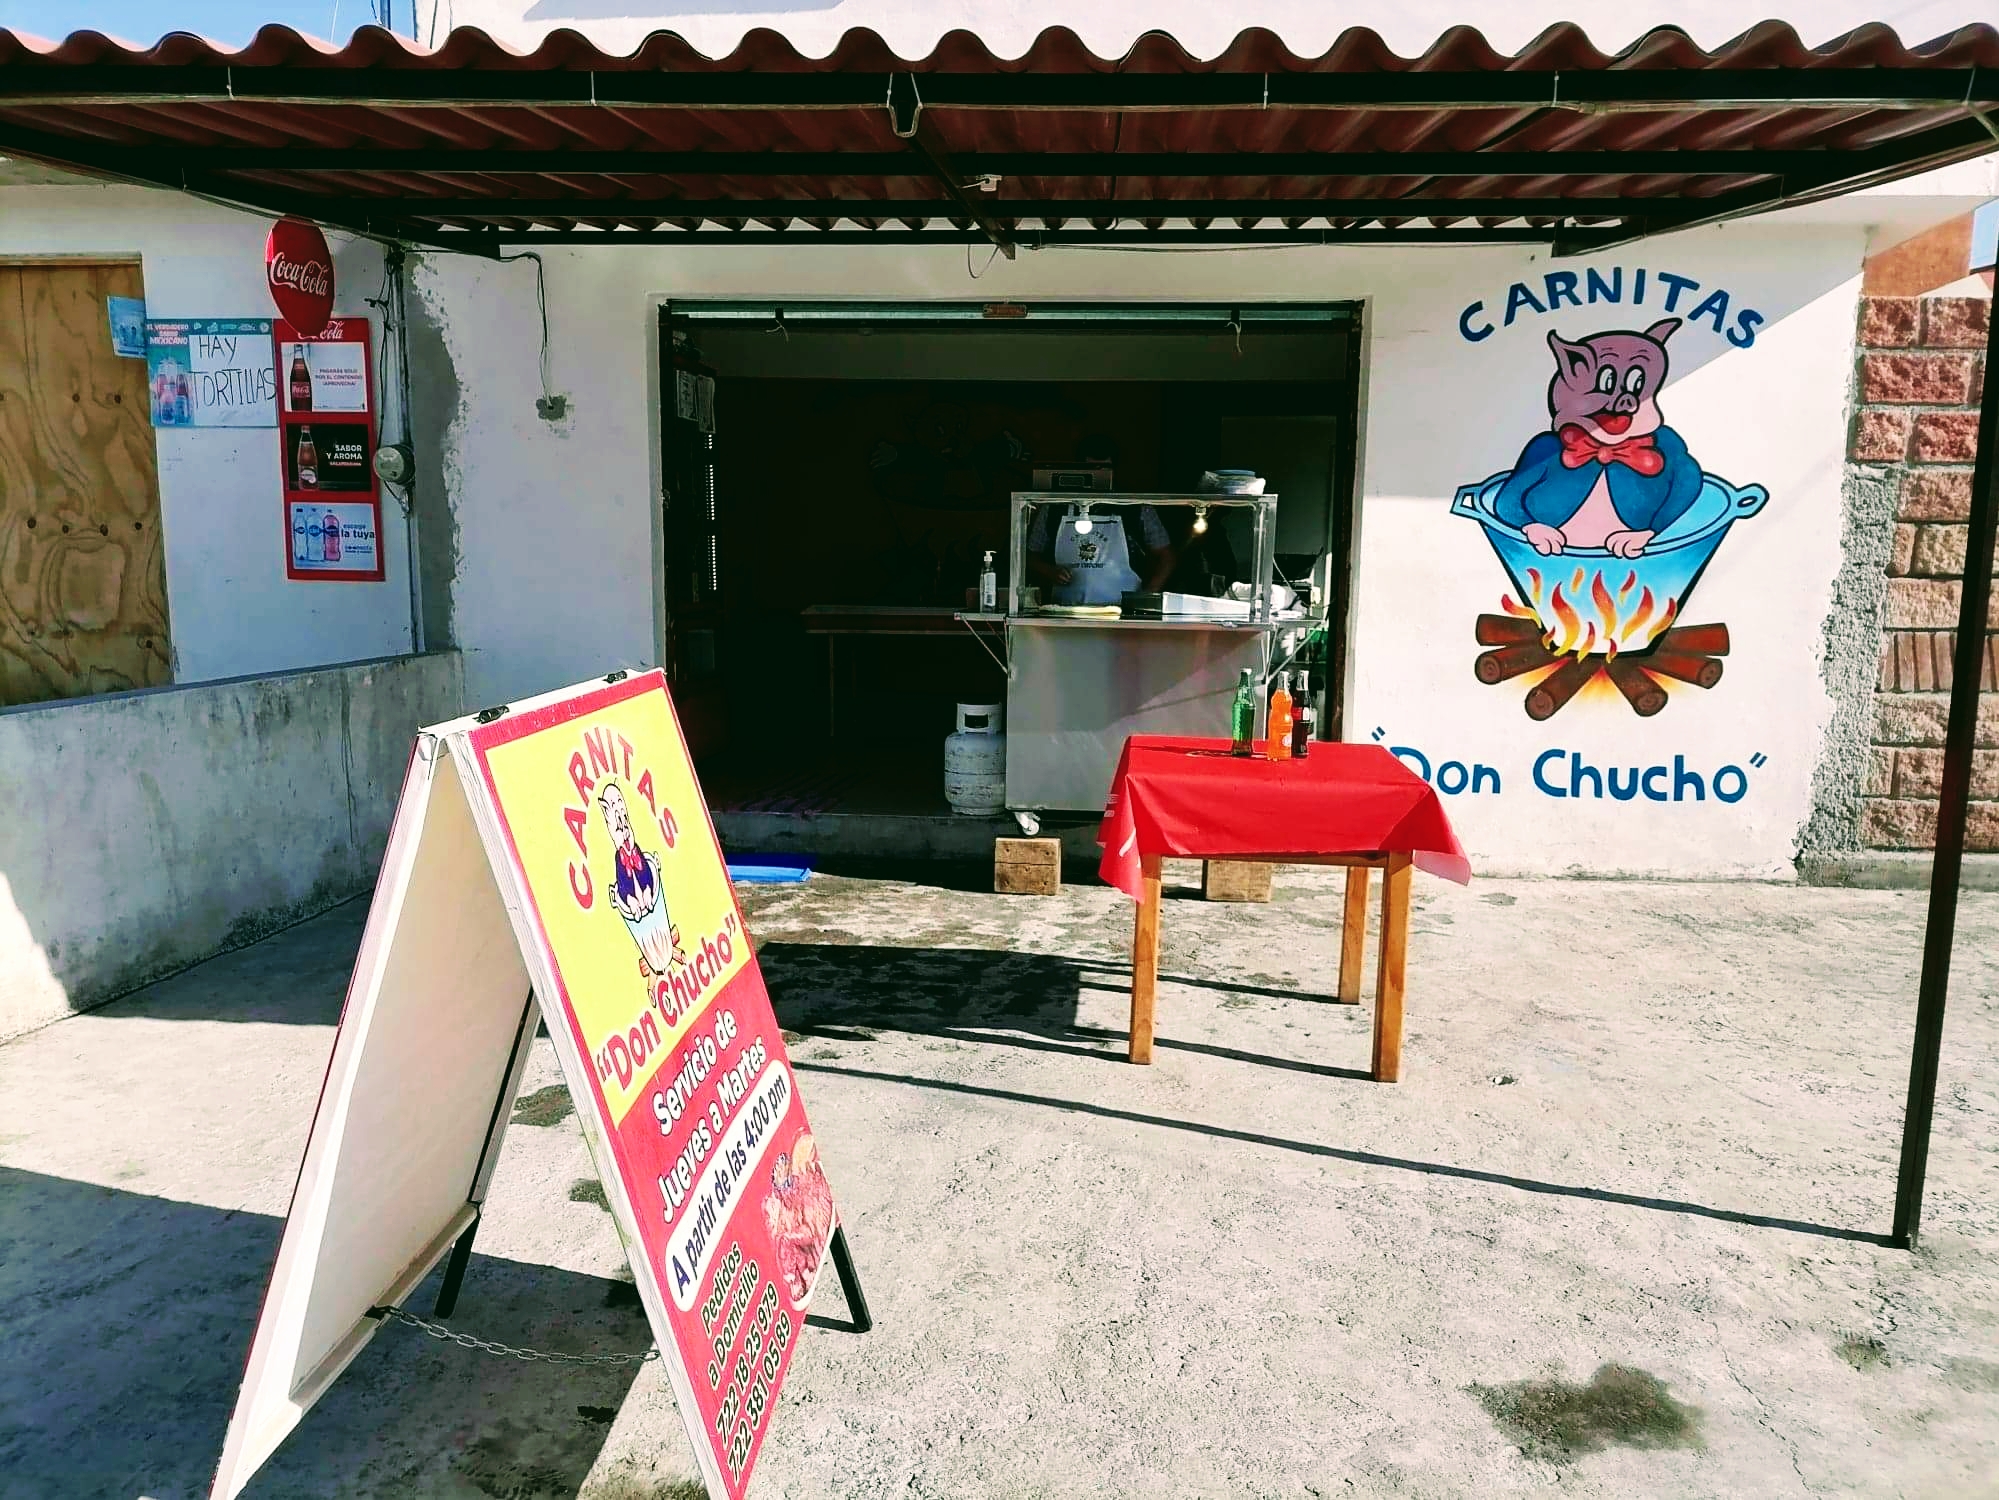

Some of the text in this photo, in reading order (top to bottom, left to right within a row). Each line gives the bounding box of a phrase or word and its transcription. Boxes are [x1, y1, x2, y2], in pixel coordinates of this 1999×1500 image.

[199, 335, 237, 364] HAY
[1459, 267, 1764, 348] CARNITAS
[188, 368, 276, 408] TORTILLAS
[326, 452, 362, 460] Y AROMA
[335, 444, 362, 452] SABOR
[341, 529, 375, 540] la tuya
[564, 727, 678, 909] CARNITAS
[1532, 749, 1768, 803] Chucho"
[653, 1008, 738, 1136] Servicio de
[657, 1036, 766, 1223] Jueves a Martes
[672, 1074, 787, 1298] A partir de las 4:00 pm
[709, 1261, 758, 1387] a Domicilio
[717, 1283, 777, 1445] 722 18 25 979
[729, 1312, 790, 1481] 722 381 05 89
